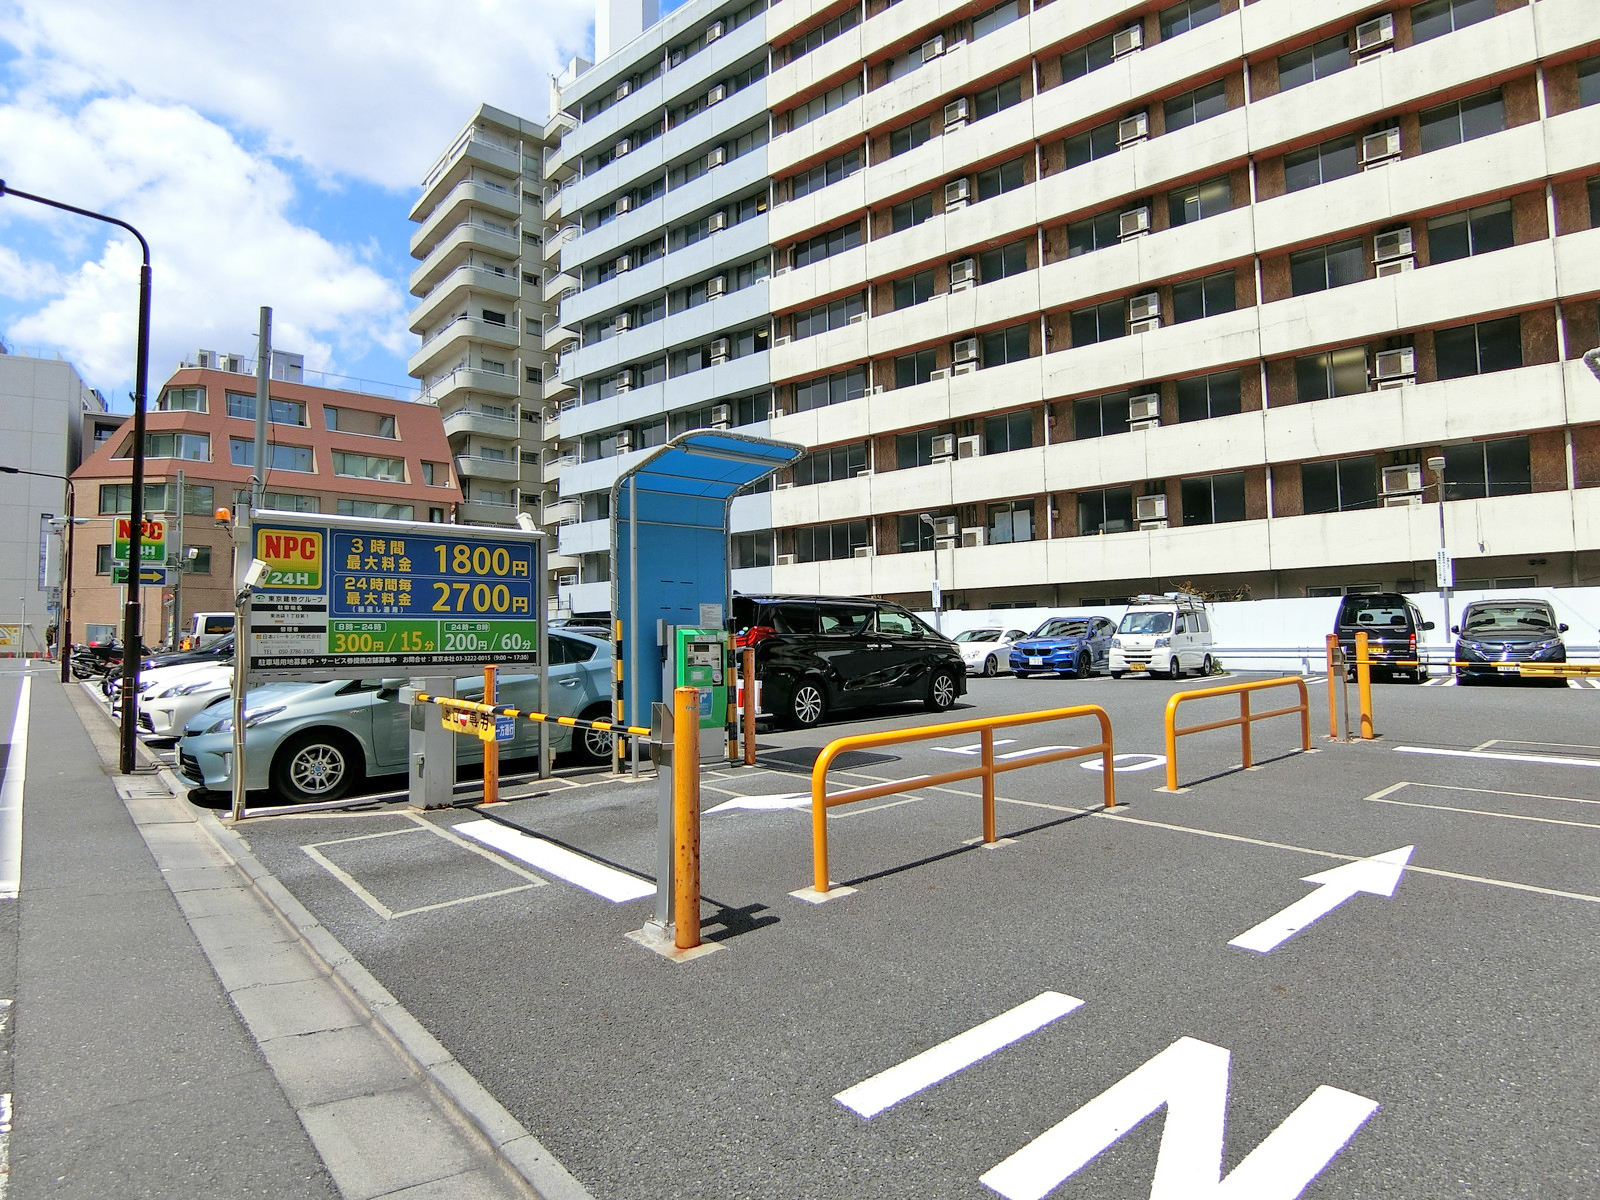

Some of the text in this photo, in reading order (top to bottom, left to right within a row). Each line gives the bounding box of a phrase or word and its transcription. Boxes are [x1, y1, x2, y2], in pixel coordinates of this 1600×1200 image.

[265, 535, 315, 560] NPC
[351, 538, 405, 555] 3時間
[346, 554, 412, 572] 最大料金
[434, 544, 528, 576] 1800円
[271, 571, 309, 585] 24H
[344, 577, 412, 592] 24時間毎
[268, 595, 323, 603] 東京建物グループ
[346, 592, 412, 606] 最大料金
[432, 582, 528, 612] 2700円
[496, 724, 514, 736] 一方通行
